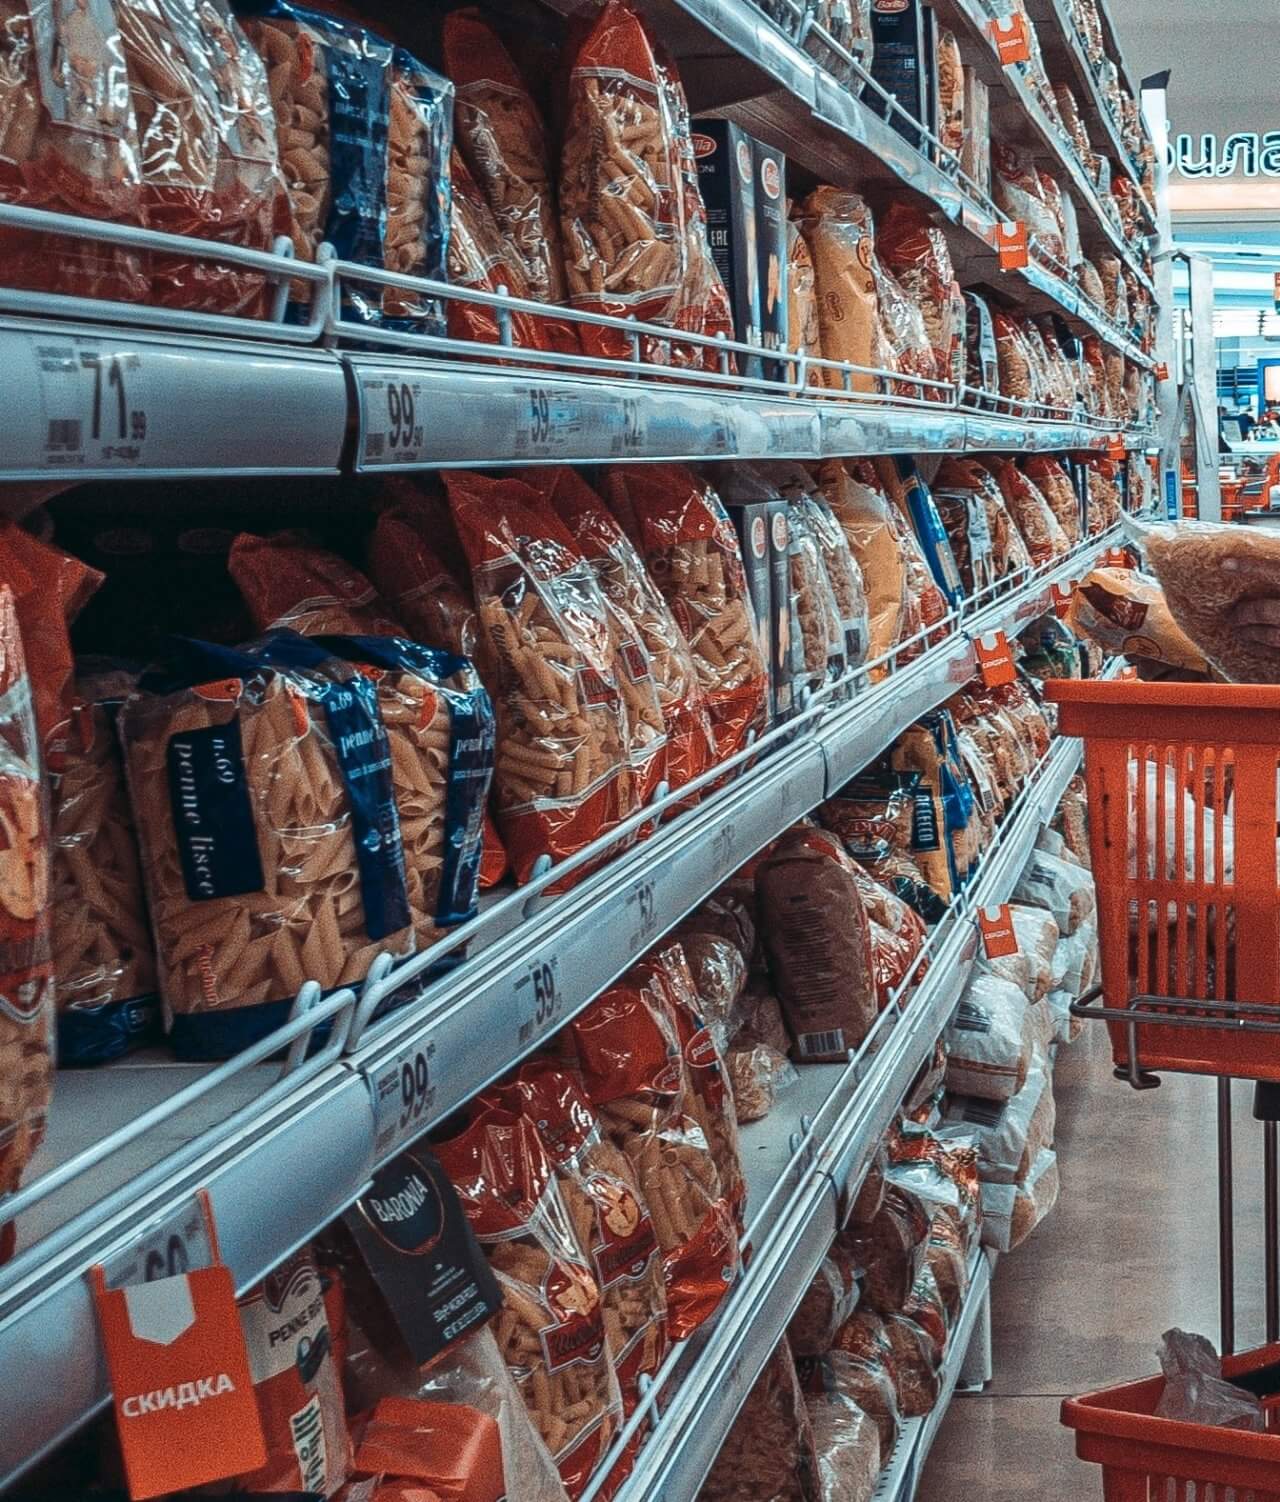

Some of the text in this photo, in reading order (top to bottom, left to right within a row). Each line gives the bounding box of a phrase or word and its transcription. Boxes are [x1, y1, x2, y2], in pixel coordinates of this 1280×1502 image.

[711, 230, 728, 246] EAC
[80, 357, 128, 440] 71
[387, 383, 414, 448] 99
[212, 738, 236, 784] n.69
[173, 743, 215, 895] penne lisce
[532, 962, 555, 1025] 59
[401, 1052, 429, 1130] 99
[268, 1309, 309, 1349] PENNE
[121, 1373, 237, 1418] СКИДКА
